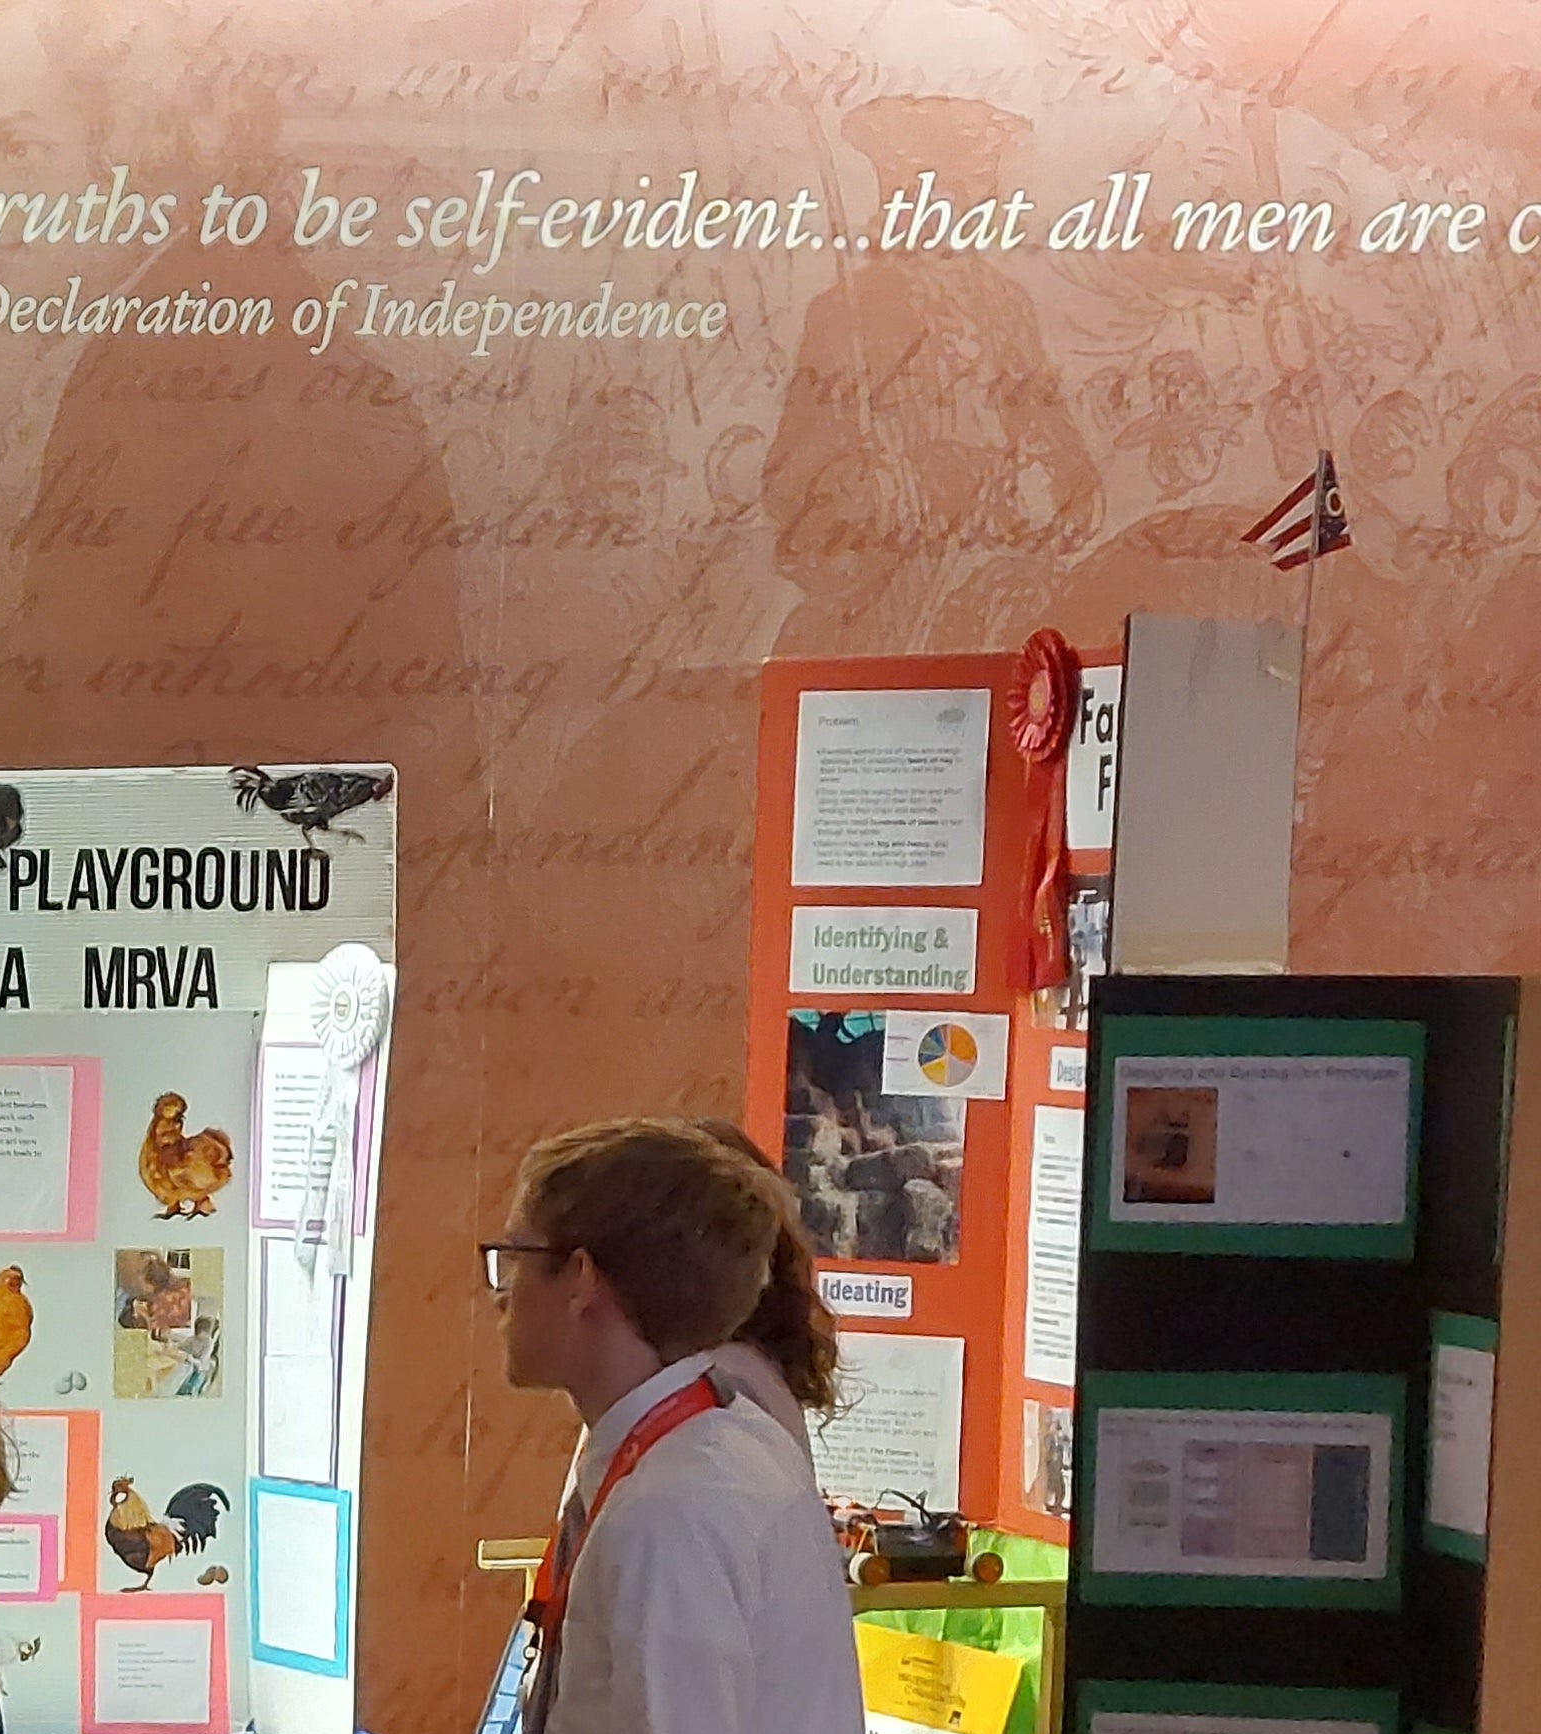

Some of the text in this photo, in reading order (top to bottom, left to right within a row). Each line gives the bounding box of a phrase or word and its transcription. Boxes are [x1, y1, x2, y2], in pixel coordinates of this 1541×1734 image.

[200, 180, 268, 248] to
[293, 167, 376, 248] be
[1048, 171, 1152, 251] all
[1171, 200, 1336, 253] men
[1359, 201, 1486, 253] are
[291, 281, 358, 355] of
[354, 281, 727, 357] Independence
[9, 847, 331, 914] PLAYGROUND
[813, 924, 949, 953] Identifying &
[84, 946, 219, 1009] MRVA
[812, 963, 969, 991] Understanding
[821, 1279, 909, 1310] Ideating
